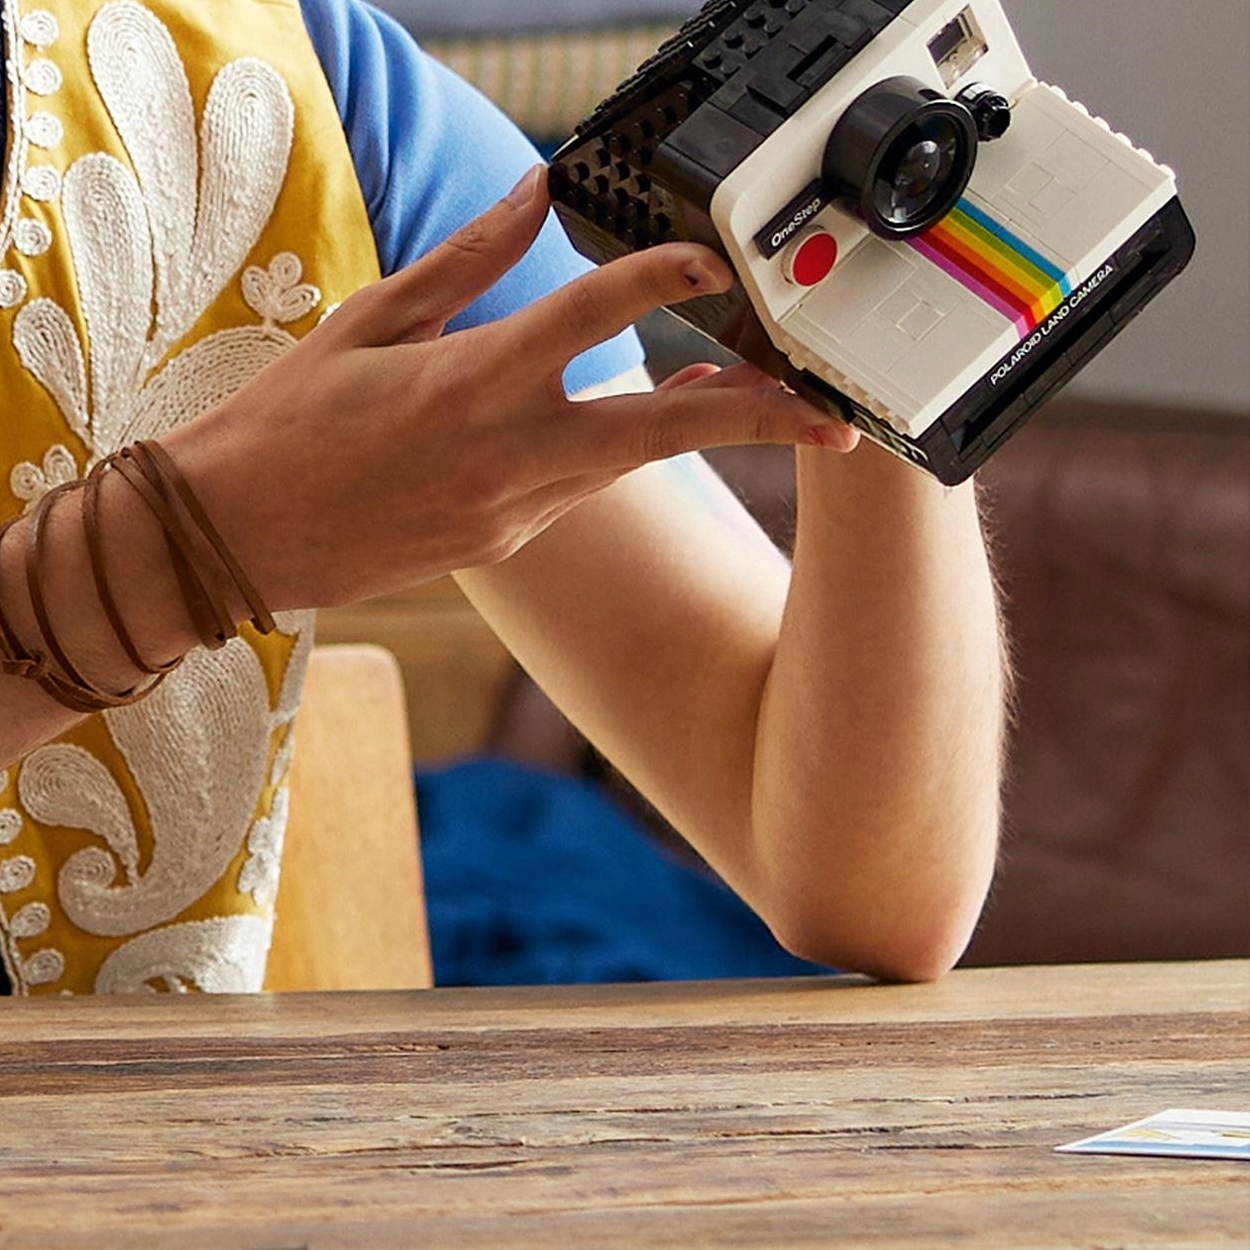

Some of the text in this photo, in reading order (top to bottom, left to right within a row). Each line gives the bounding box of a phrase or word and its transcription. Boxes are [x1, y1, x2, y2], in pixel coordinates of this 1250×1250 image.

[771, 198, 820, 247] OneStep
[990, 265, 1113, 386] POLAROID LAND CAMERA
